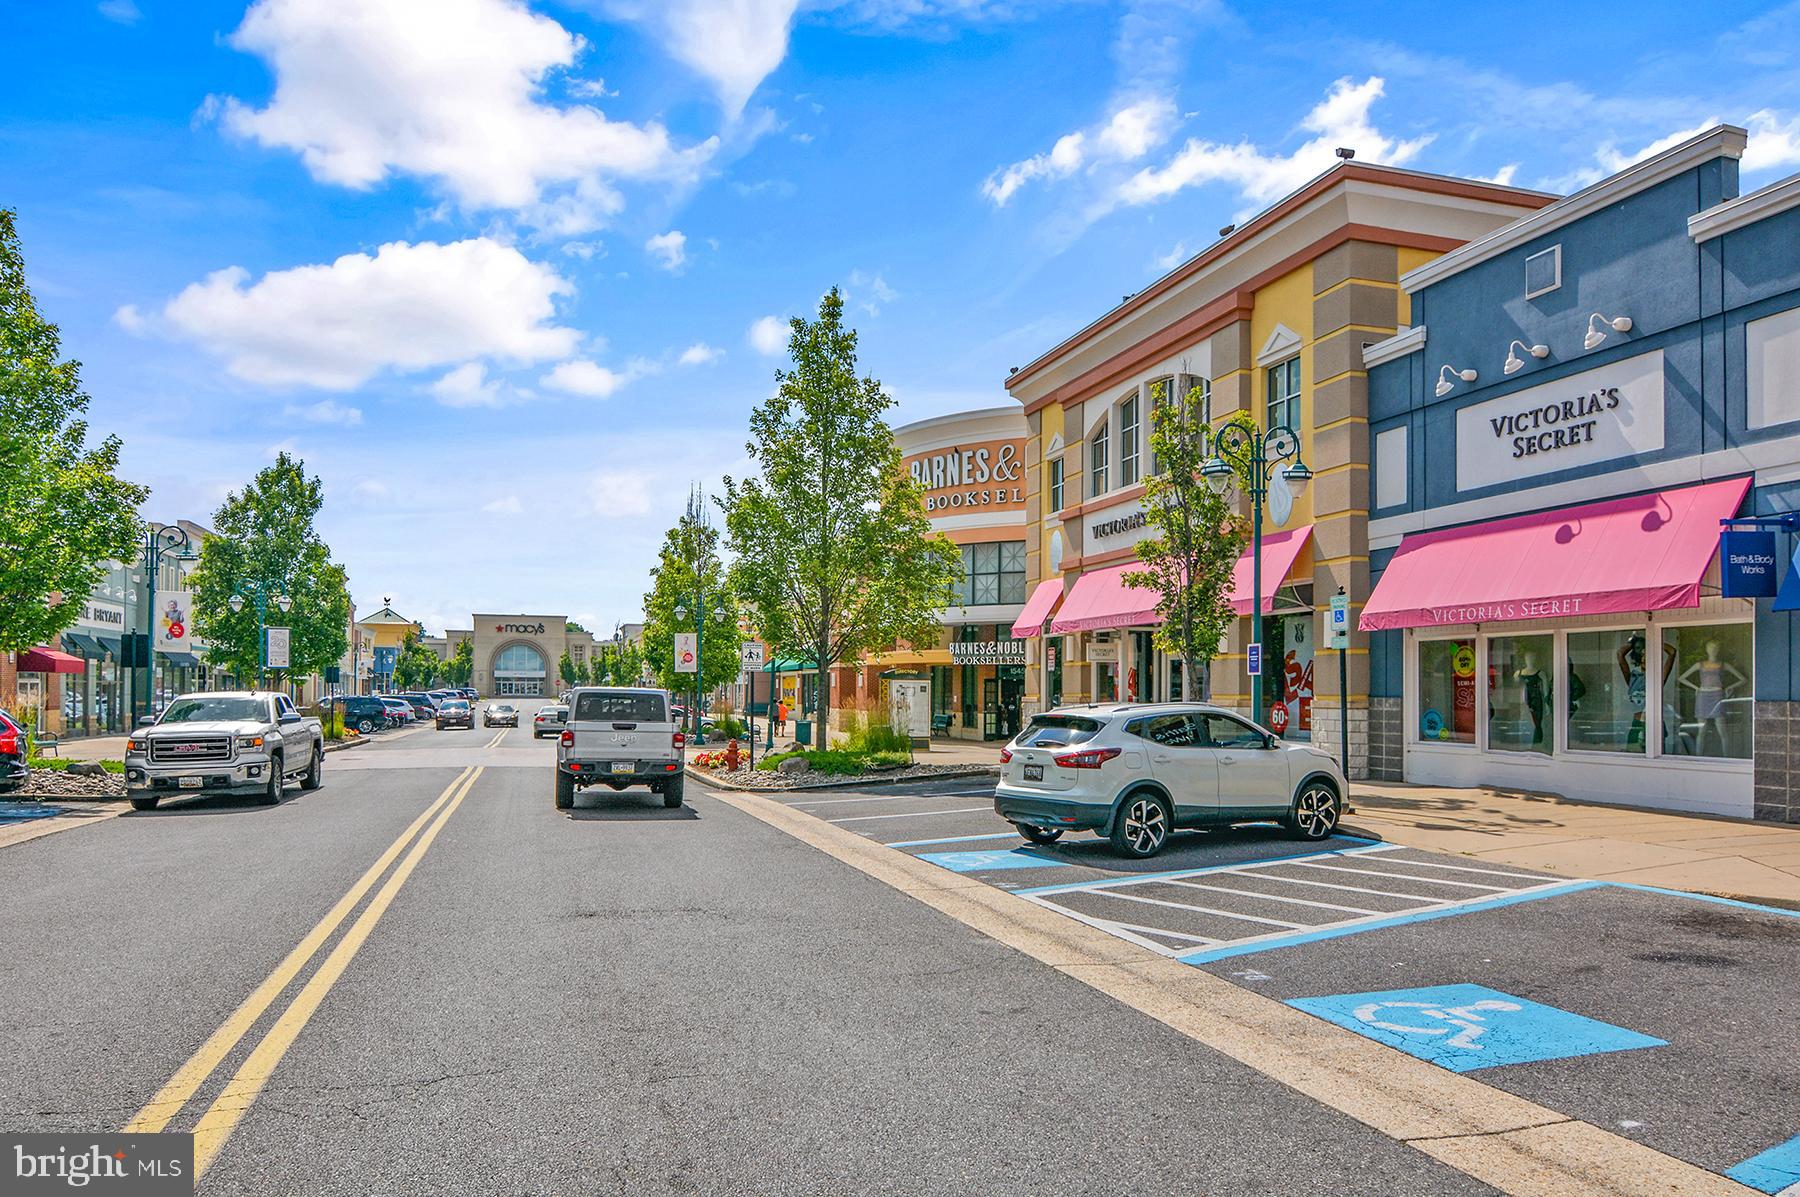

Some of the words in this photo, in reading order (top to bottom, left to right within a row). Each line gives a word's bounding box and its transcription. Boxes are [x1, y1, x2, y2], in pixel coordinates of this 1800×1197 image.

[1490, 388, 1619, 438] VICTORIA'S
[1512, 420, 1597, 458] SECRET
[1741, 566, 1765, 574] Works
[93, 607, 123, 624] BRYANT
[1433, 604, 1515, 622] VICTORIA'S
[1520, 598, 1583, 616] SECRET
[1113, 614, 1135, 626] SECRET
[505, 622, 545, 636] macy's
[610, 733, 638, 744] Jeep
